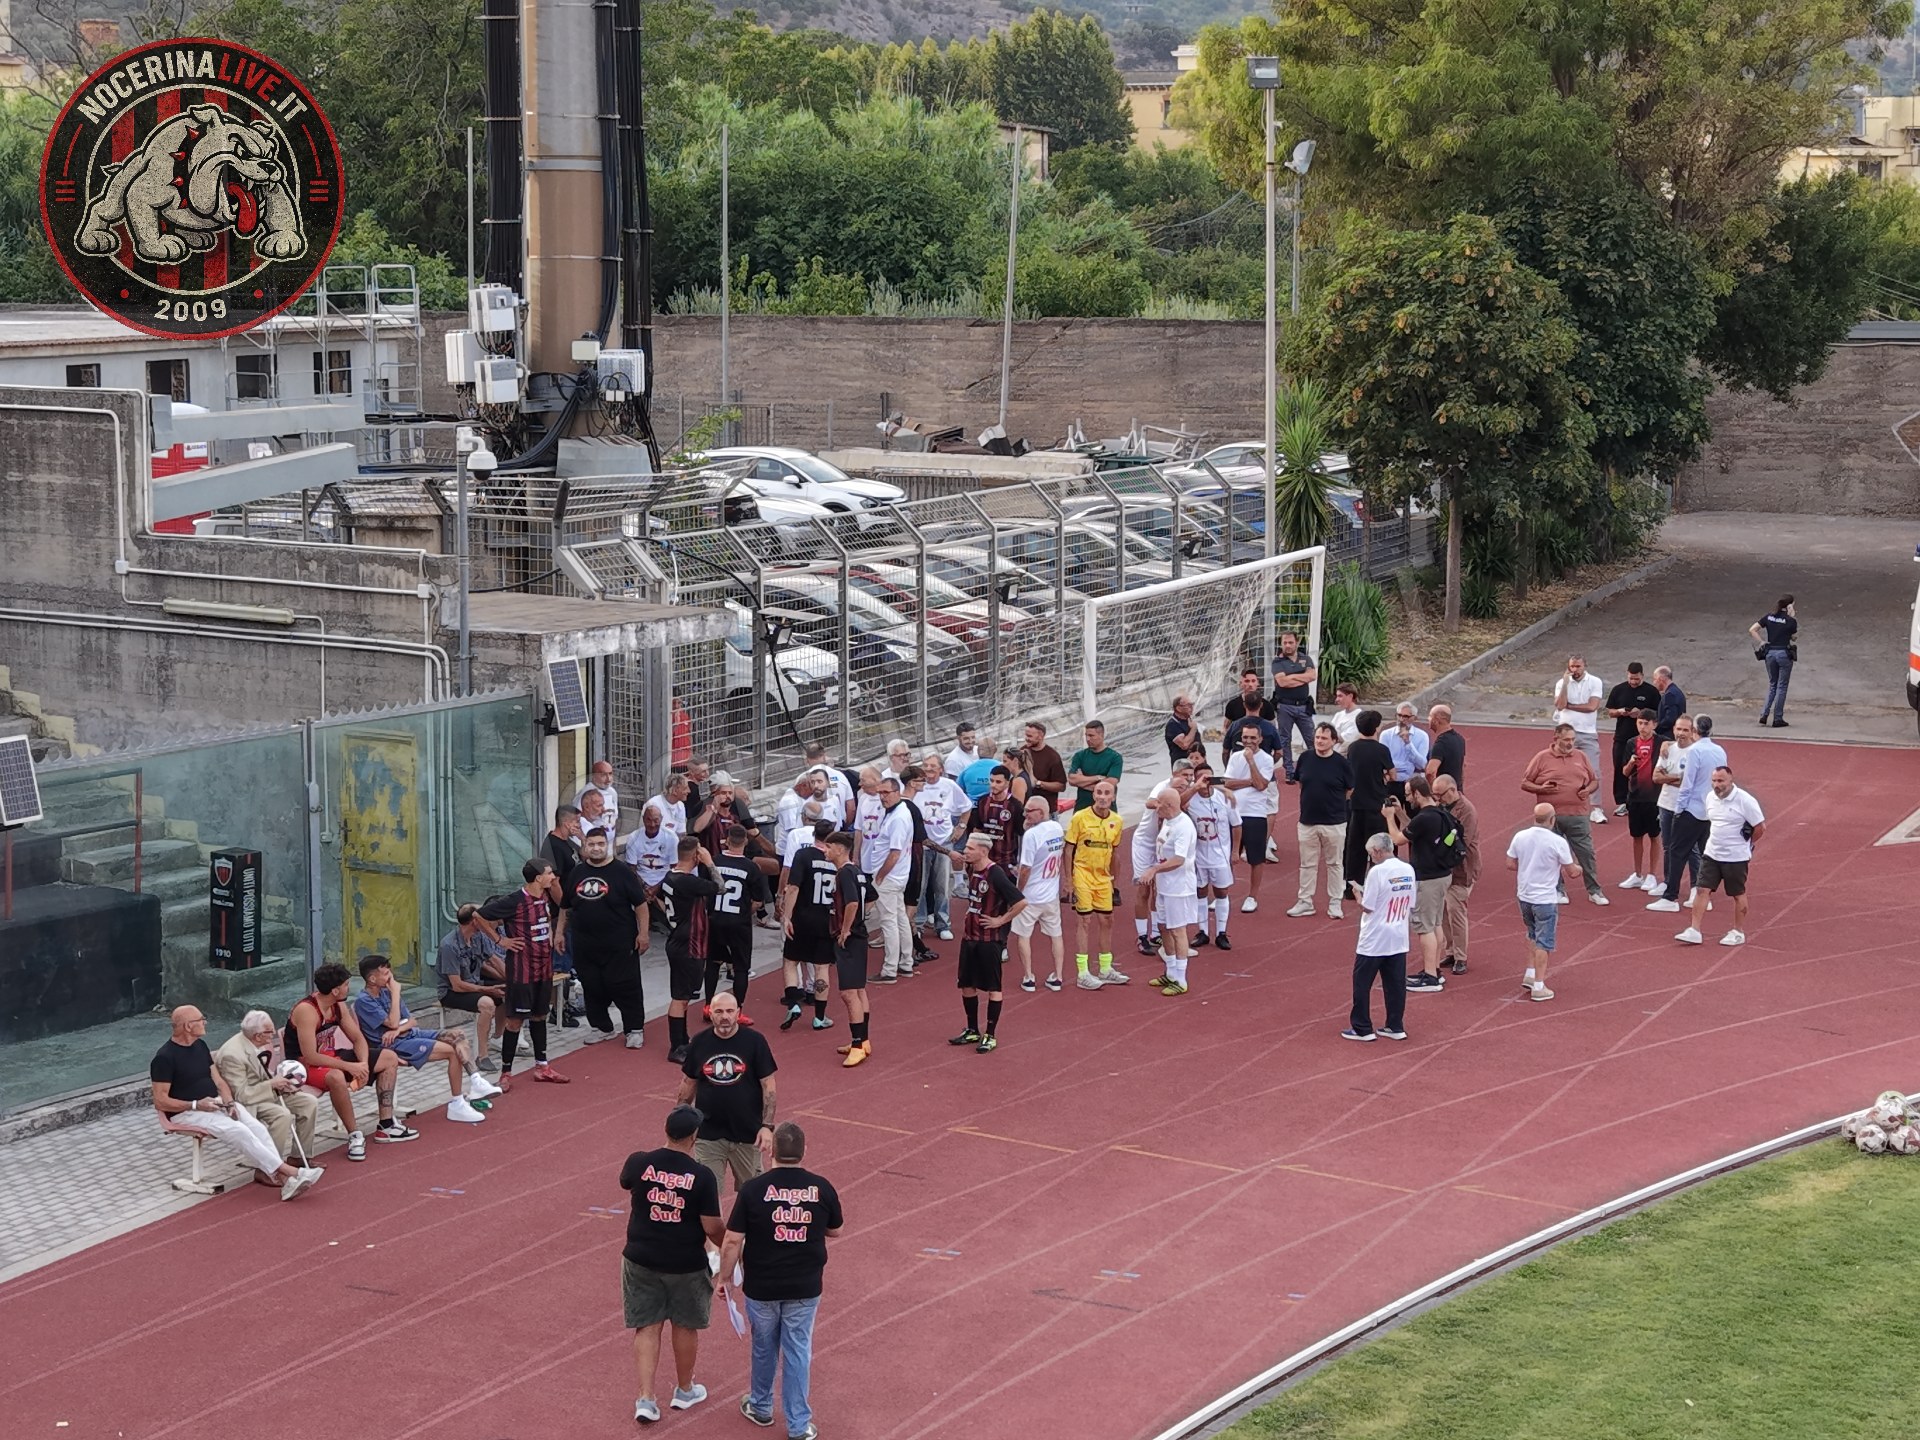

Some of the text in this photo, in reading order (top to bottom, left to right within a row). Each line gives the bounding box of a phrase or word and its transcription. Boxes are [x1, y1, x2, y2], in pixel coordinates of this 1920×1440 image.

[1386, 894, 1411, 923] 1910
[215, 948, 231, 958] 1910
[641, 1164, 696, 1190] Angeli
[647, 1187, 685, 1210] della
[764, 1184, 819, 1206] Angeli
[650, 1205, 682, 1223] Sud
[772, 1206, 812, 1224] della
[774, 1225, 807, 1242] Sud
